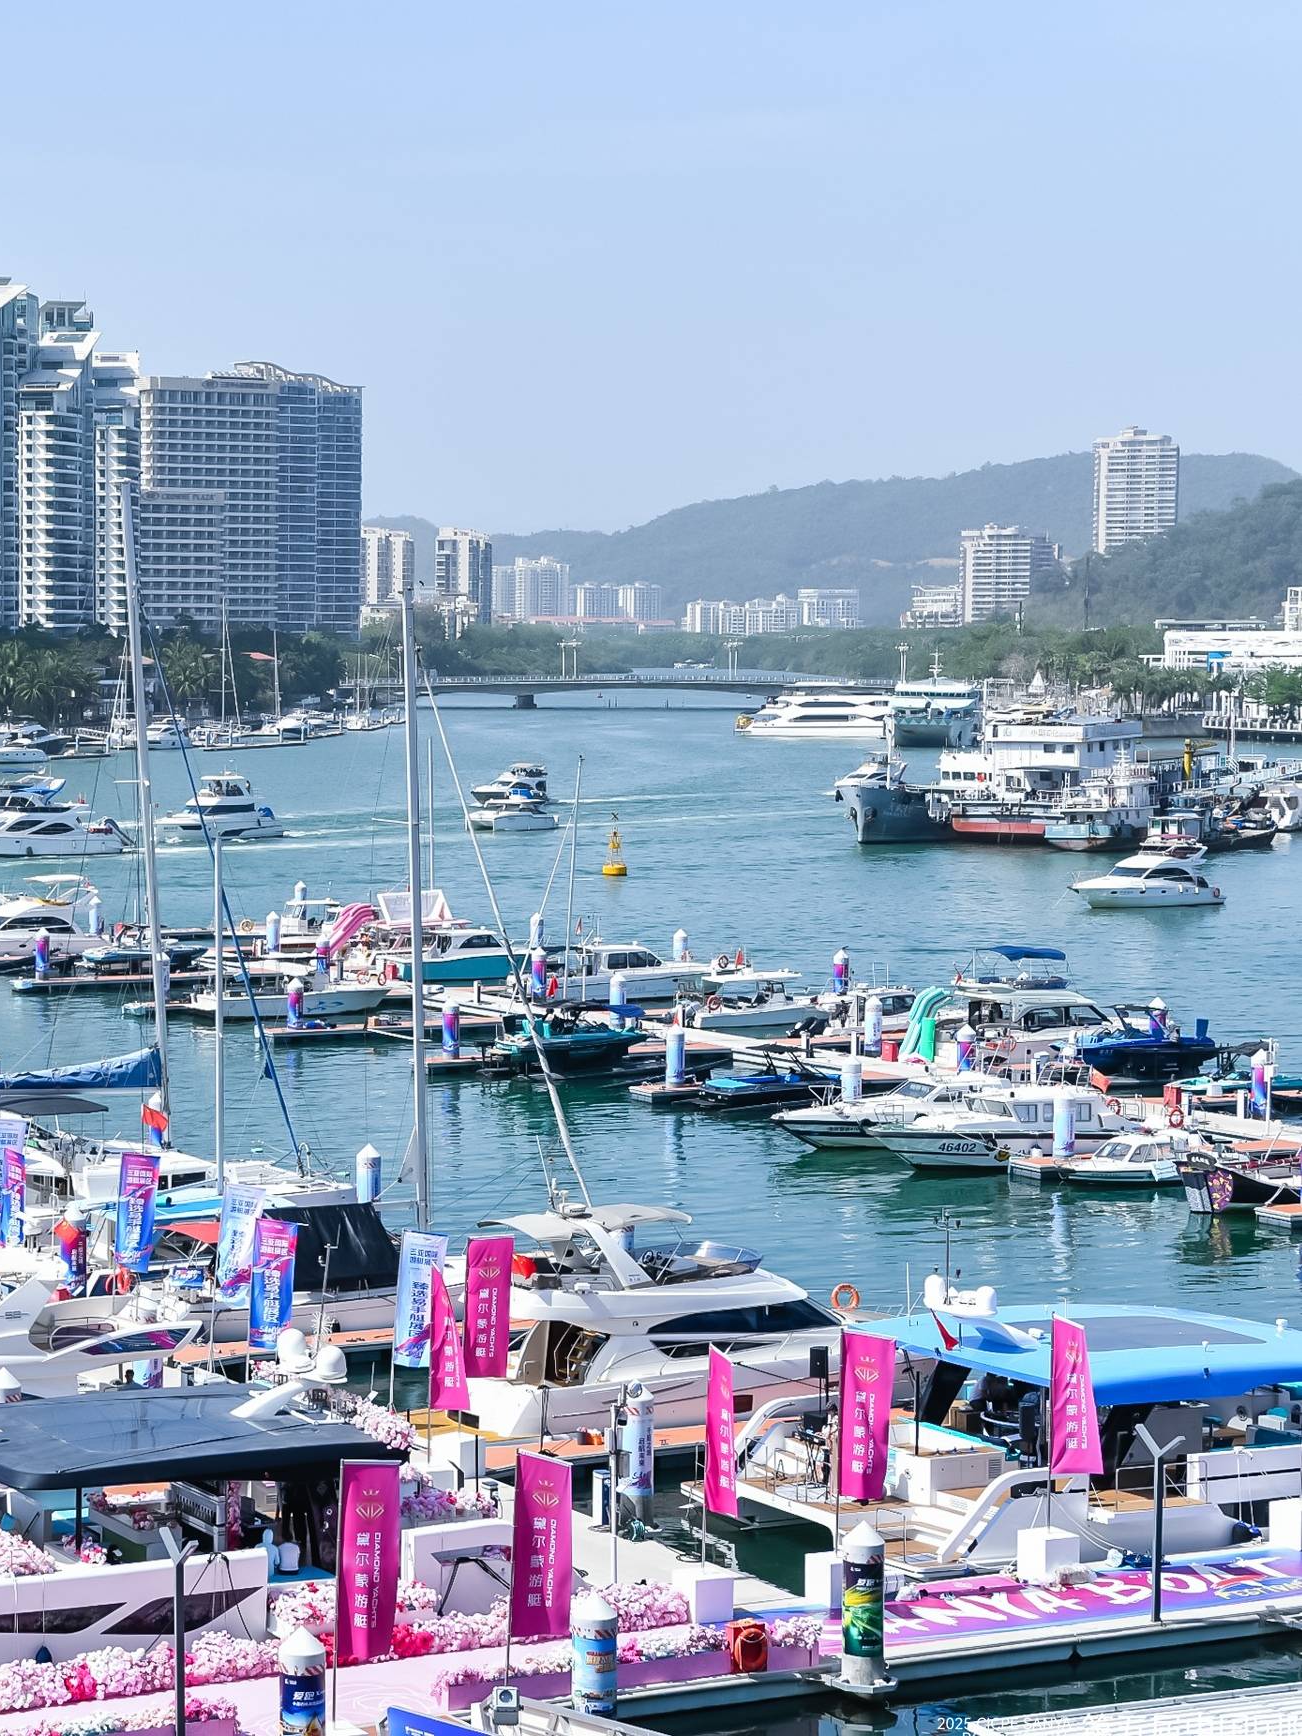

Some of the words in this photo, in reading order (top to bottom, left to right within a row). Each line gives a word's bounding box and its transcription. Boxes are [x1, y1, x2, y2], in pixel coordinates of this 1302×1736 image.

[938, 1143, 977, 1153] 46402
[374, 1532, 382, 1583] DIAMOND
[527, 1516, 547, 1607] 黛尔蒙游艇
[548, 1519, 558, 1565] DIAMOND
[354, 1532, 370, 1628] 黛尔蒙游艇
[546, 1568, 555, 1608] YACHTS
[1084, 1557, 1291, 1605] BOAT
[371, 1587, 379, 1629] YACHTS
